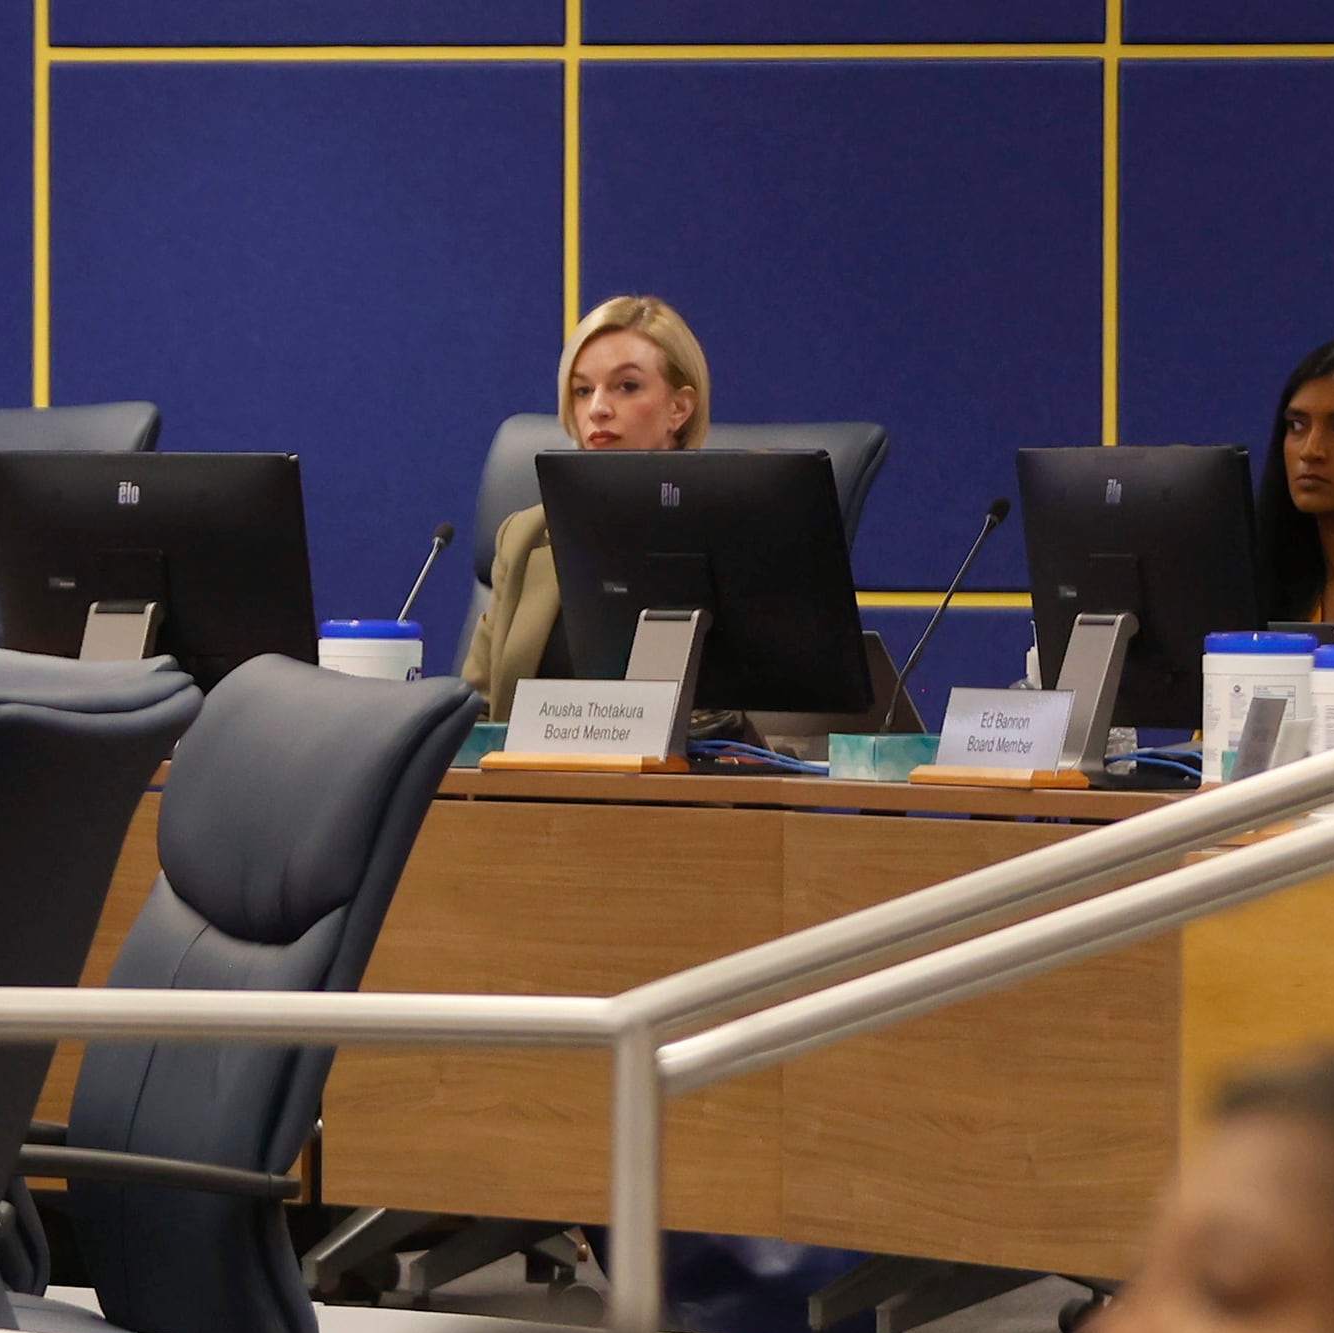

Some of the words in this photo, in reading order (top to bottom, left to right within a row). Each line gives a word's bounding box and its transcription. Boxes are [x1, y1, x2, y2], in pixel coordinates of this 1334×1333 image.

[539, 701, 583, 718] Anusha
[587, 702, 644, 719] Thotakura
[981, 711, 995, 729] Ed
[995, 712, 1031, 730] Bannon
[544, 723, 580, 740] Board
[583, 725, 631, 741] Member
[967, 735, 995, 753] Board
[995, 737, 1033, 754] Member
